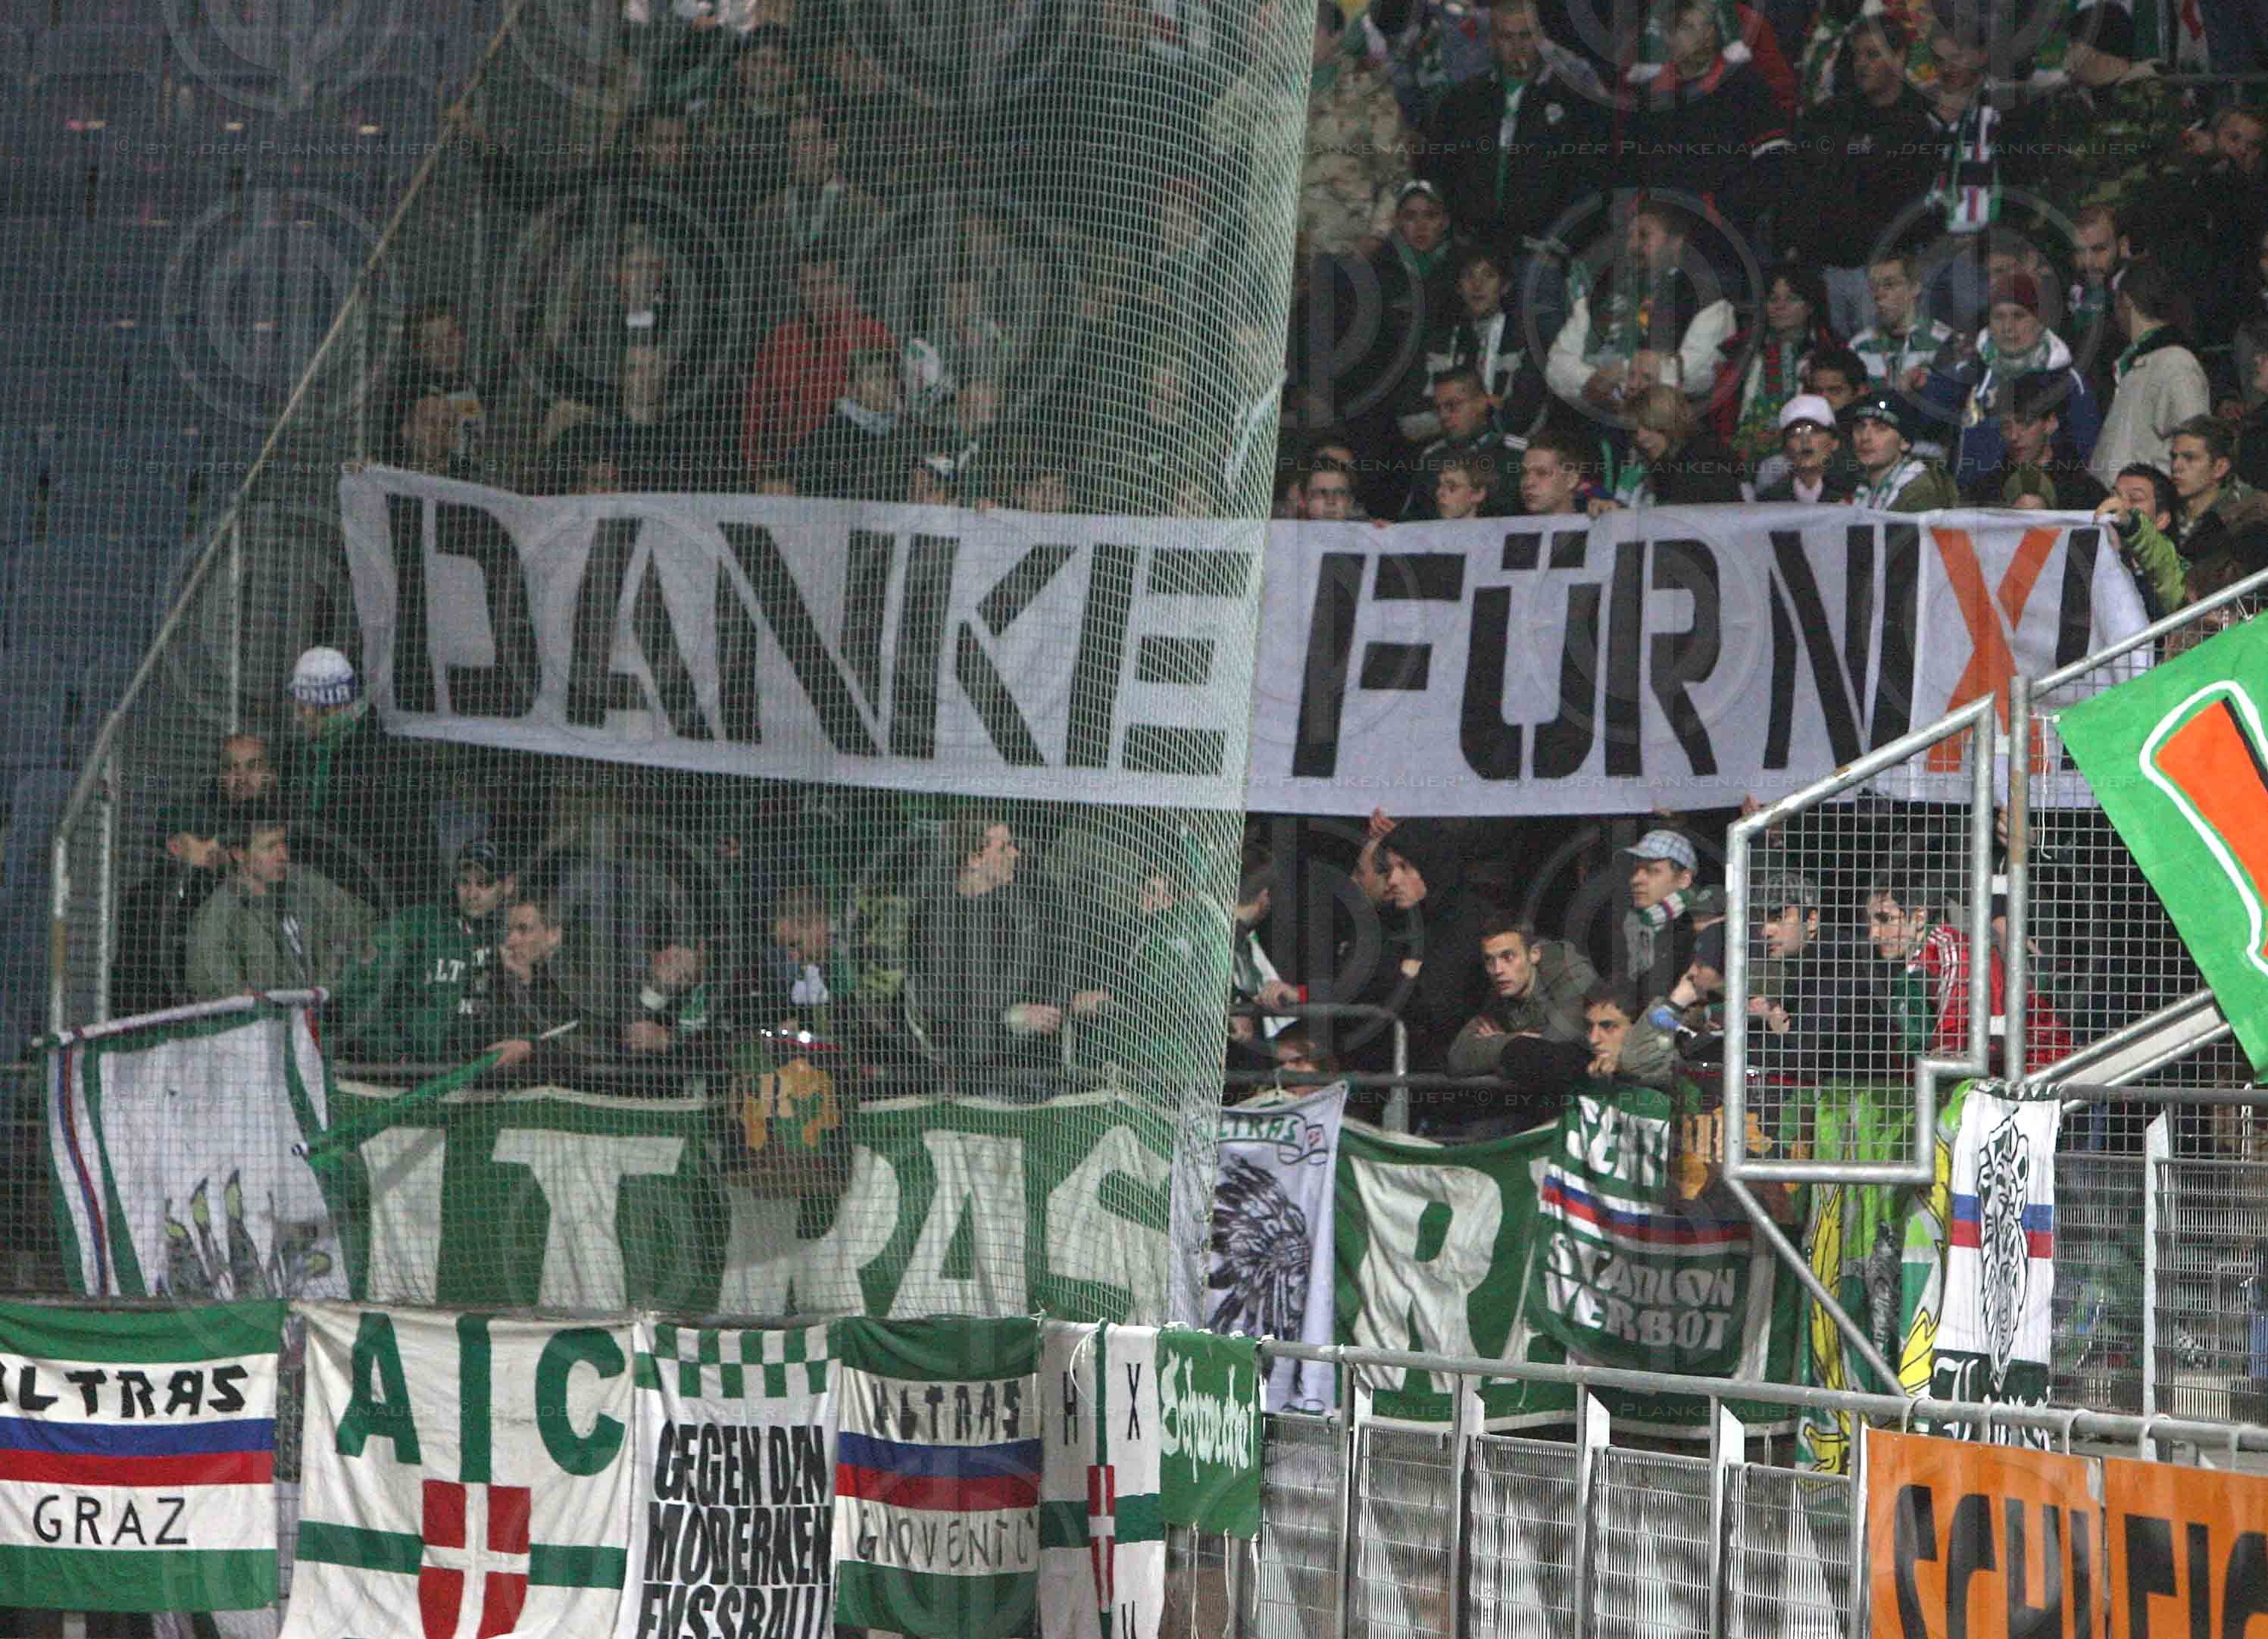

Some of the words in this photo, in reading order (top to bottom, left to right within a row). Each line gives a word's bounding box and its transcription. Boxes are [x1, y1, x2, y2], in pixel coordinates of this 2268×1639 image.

[385, 493, 1251, 777] DANKE
[1292, 530, 1718, 780] FÜR
[1548, 1231, 1736, 1308] STADION
[1545, 1271, 1732, 1352] VERBOT
[0, 1361, 248, 1418] LTRAS
[335, 1312, 626, 1484] AIC
[872, 1381, 1021, 1440] ULTRAS
[654, 1420, 762, 1507] GEGEN
[767, 1425, 827, 1506] DEN
[33, 1494, 189, 1547] GRAZ
[644, 1501, 833, 1587] MODERNEN
